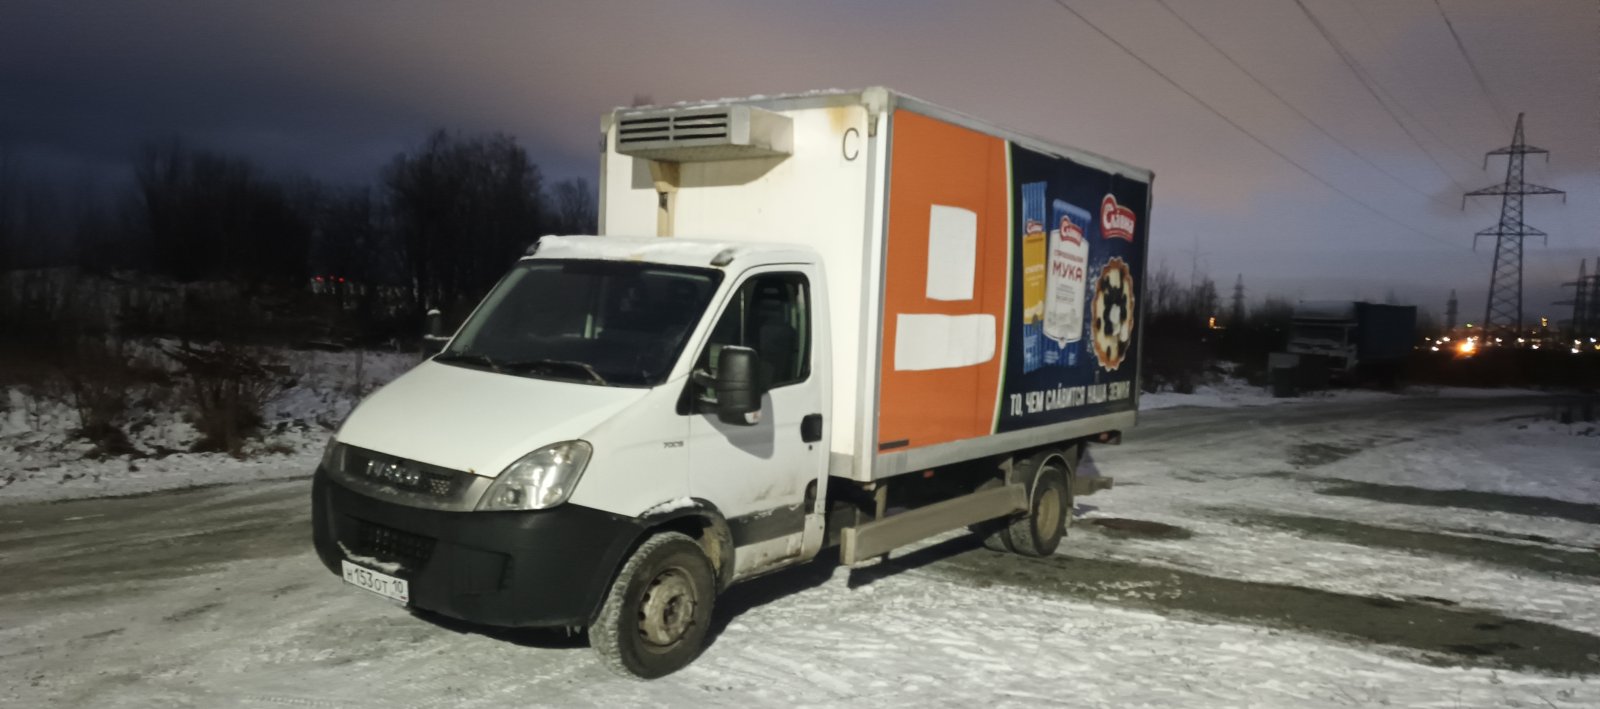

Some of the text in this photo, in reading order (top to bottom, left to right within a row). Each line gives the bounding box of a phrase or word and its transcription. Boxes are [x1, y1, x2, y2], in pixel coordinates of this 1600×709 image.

[1052, 260, 1083, 283] МУКА
[1010, 393, 1023, 416] ТО,
[1025, 390, 1045, 414] ЧЕМ
[1087, 384, 1107, 405] НАША
[1108, 380, 1131, 401] ЗЕМЛЯ
[392, 580, 404, 594] 10
